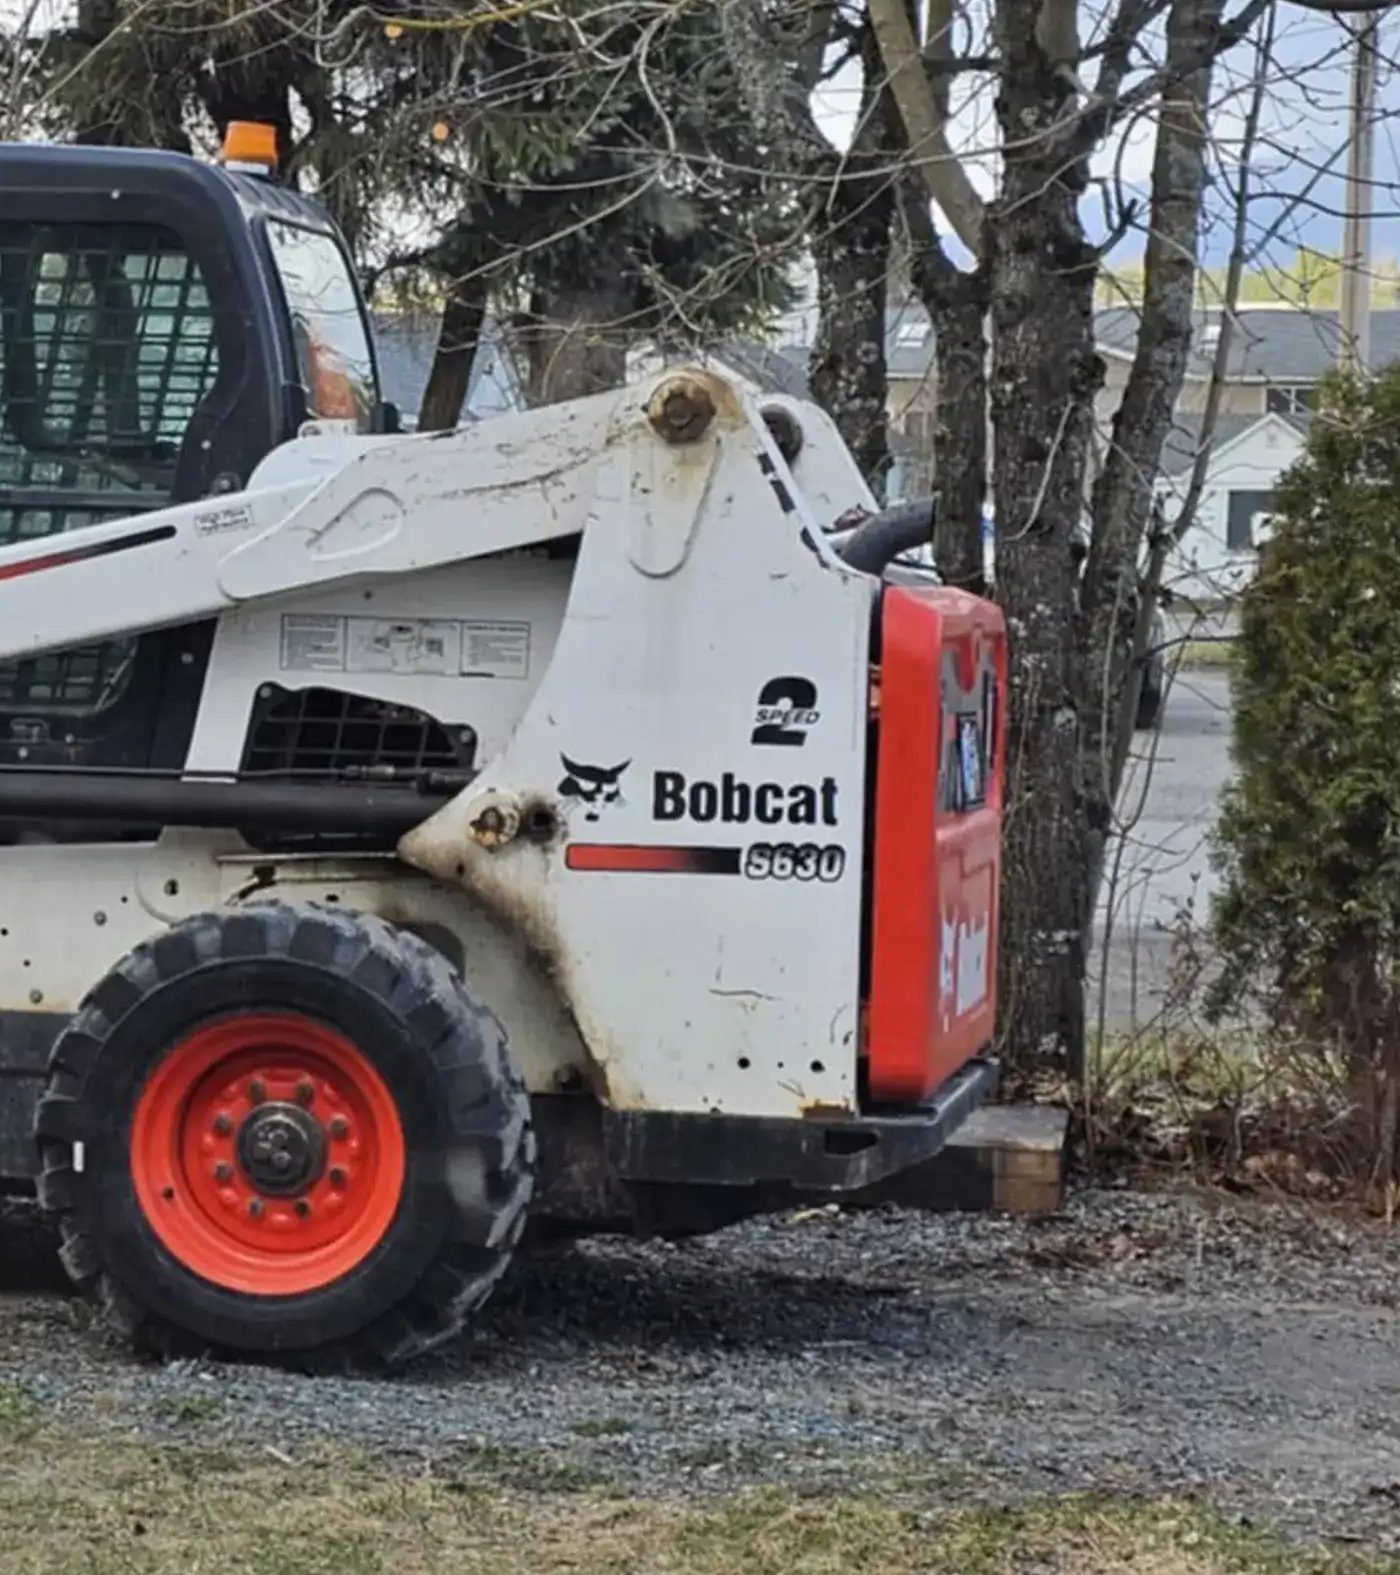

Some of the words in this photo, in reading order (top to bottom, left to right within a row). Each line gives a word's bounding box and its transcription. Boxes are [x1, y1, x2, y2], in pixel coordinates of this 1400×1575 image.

[751, 676, 818, 747] 2
[755, 708, 821, 725] SPEED
[653, 769, 839, 827] Bobcat
[745, 842, 846, 883] S630
